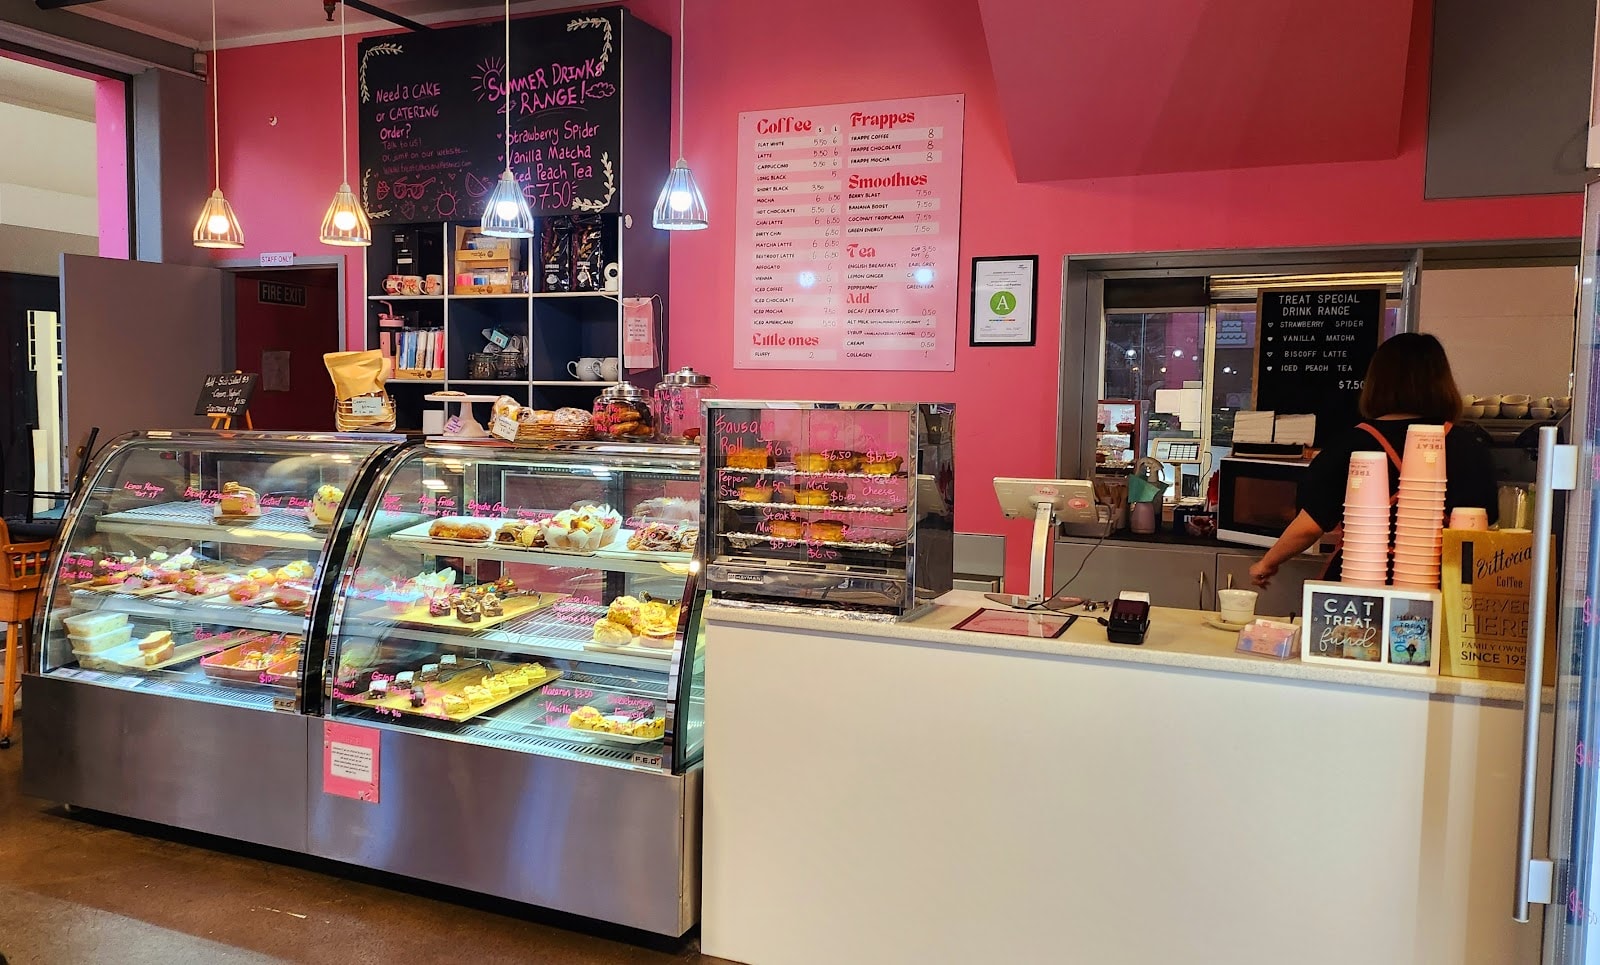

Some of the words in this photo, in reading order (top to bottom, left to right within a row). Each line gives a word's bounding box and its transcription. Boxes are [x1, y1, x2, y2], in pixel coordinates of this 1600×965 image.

[487, 68, 547, 102] SUMMER
[552, 59, 604, 85] DRINKS
[376, 84, 399, 104] Need
[402, 86, 408, 99] a
[412, 82, 440, 99] CAKE
[520, 81, 585, 115] RANGE!
[376, 112, 386, 122] or
[389, 104, 439, 121] CATERING
[850, 111, 915, 129] Frappes
[380, 124, 411, 140] Order?
[506, 126, 559, 145] Strawberry
[564, 120, 599, 140] Spider
[757, 116, 812, 135] Coffee
[928, 129, 934, 138] 8
[548, 145, 591, 161] Matcha
[927, 141, 934, 150] 8
[926, 153, 933, 162] 8
[512, 167, 531, 182] ced
[537, 163, 567, 180] Peach
[572, 162, 592, 179] Tea
[848, 173, 927, 189] Smoothies
[522, 182, 571, 209] $7.50
[917, 200, 933, 208] 7.50
[815, 217, 820, 225] 6
[812, 240, 818, 248] 6
[847, 244, 875, 258] Tea
[263, 284, 281, 300] FIRE
[284, 288, 302, 303] EXIT
[846, 293, 869, 304] Add
[1279, 295, 1311, 304] TREAT
[1317, 294, 1360, 304] SPECIAL
[996, 296, 1009, 310] A
[1283, 307, 1311, 316] DRINK
[1317, 306, 1350, 315] RANGE
[753, 333, 785, 346] Little
[789, 334, 819, 346] ones
[721, 437, 743, 454] Roll
[821, 450, 851, 460] $6.50
[719, 471, 747, 484] Pepper
[806, 480, 829, 491] Mint
[1476, 546, 1532, 579] Vittoria
[1496, 576, 1523, 588] Coffee
[1324, 598, 1374, 616] CAT
[1462, 597, 1529, 614] SERVED
[1324, 614, 1372, 629] TREAT
[1320, 627, 1376, 651] fund
[1461, 642, 1494, 650] FAMILY
[1498, 644, 1527, 653] OWNE
[1461, 651, 1500, 663] SINCE
[1506, 654, 1527, 666] 195
